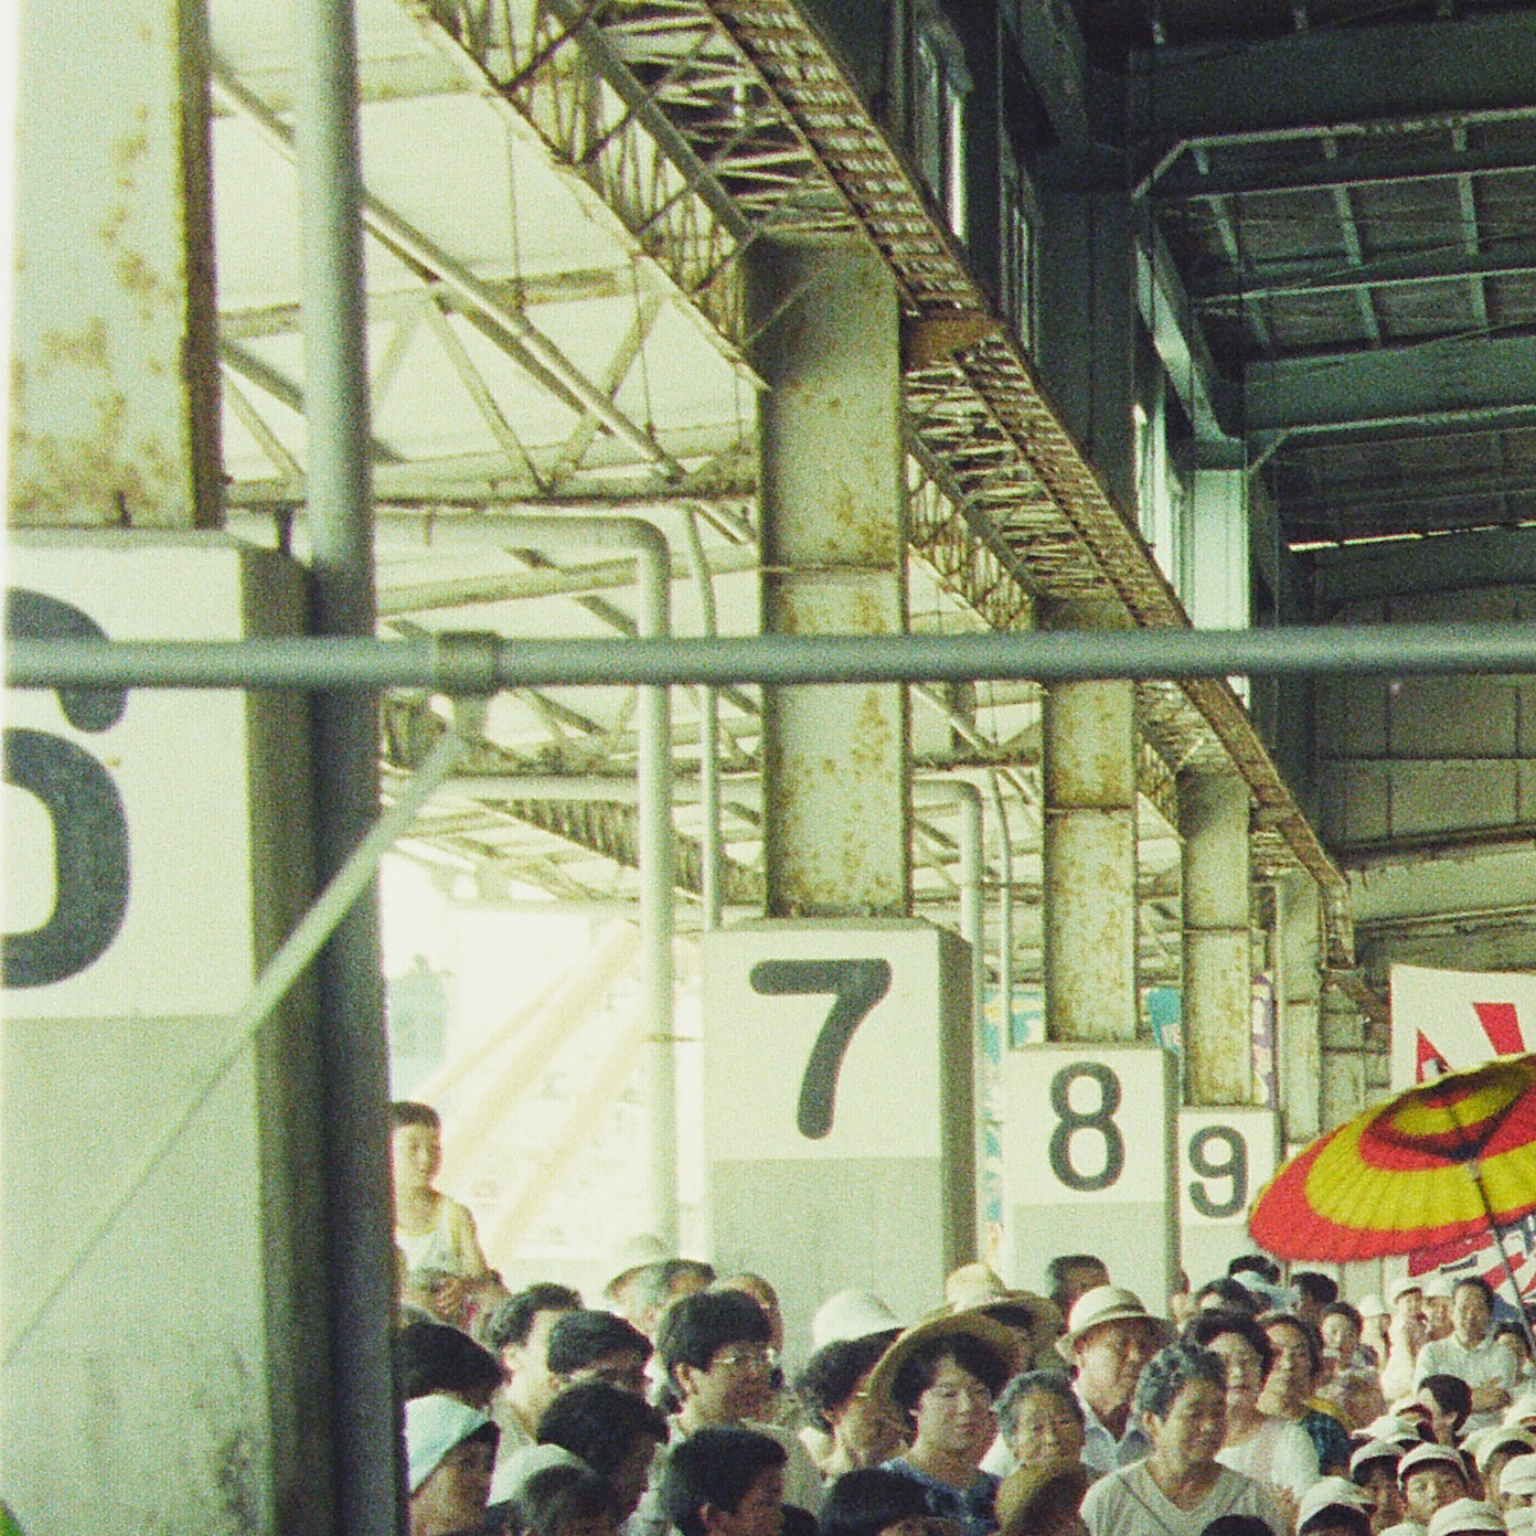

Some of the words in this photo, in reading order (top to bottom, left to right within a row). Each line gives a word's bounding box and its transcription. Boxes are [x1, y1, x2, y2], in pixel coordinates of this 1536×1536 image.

[749, 957, 893, 1140] 7
[1048, 1062, 1125, 1192] 8
[1188, 1126, 1249, 1218] 9
